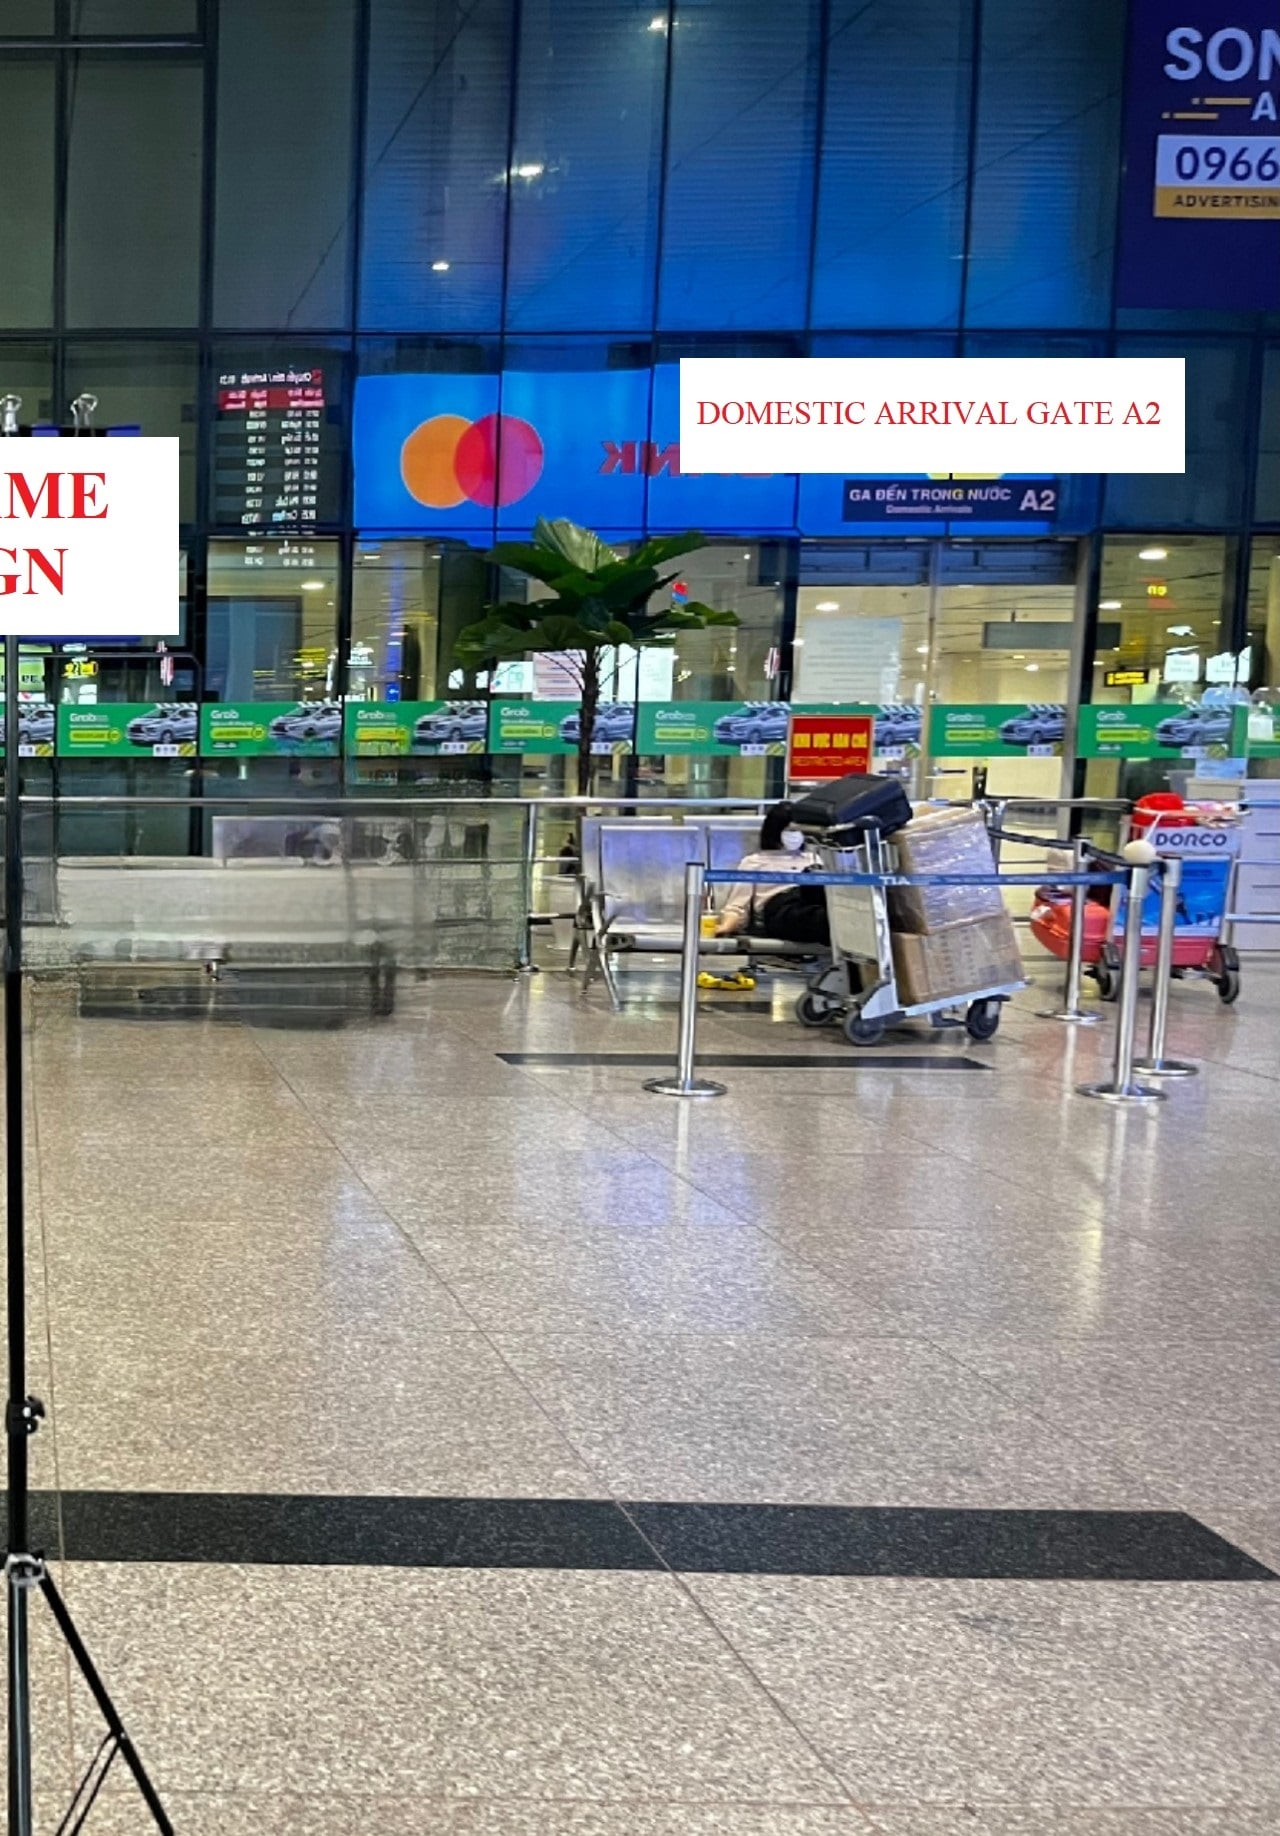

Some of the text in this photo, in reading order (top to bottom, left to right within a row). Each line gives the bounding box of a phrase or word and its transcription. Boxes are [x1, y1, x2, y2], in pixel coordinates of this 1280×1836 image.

[1175, 146, 1280, 181] 0966
[849, 488, 871, 501] GA
[875, 484, 907, 501] ĐẾN
[912, 488, 964, 501] TRONG
[1019, 489, 1056, 511] A2
[70, 712, 97, 722] Grab
[210, 710, 239, 720] Grab
[357, 710, 383, 720] Grab
[500, 707, 529, 718] Grab
